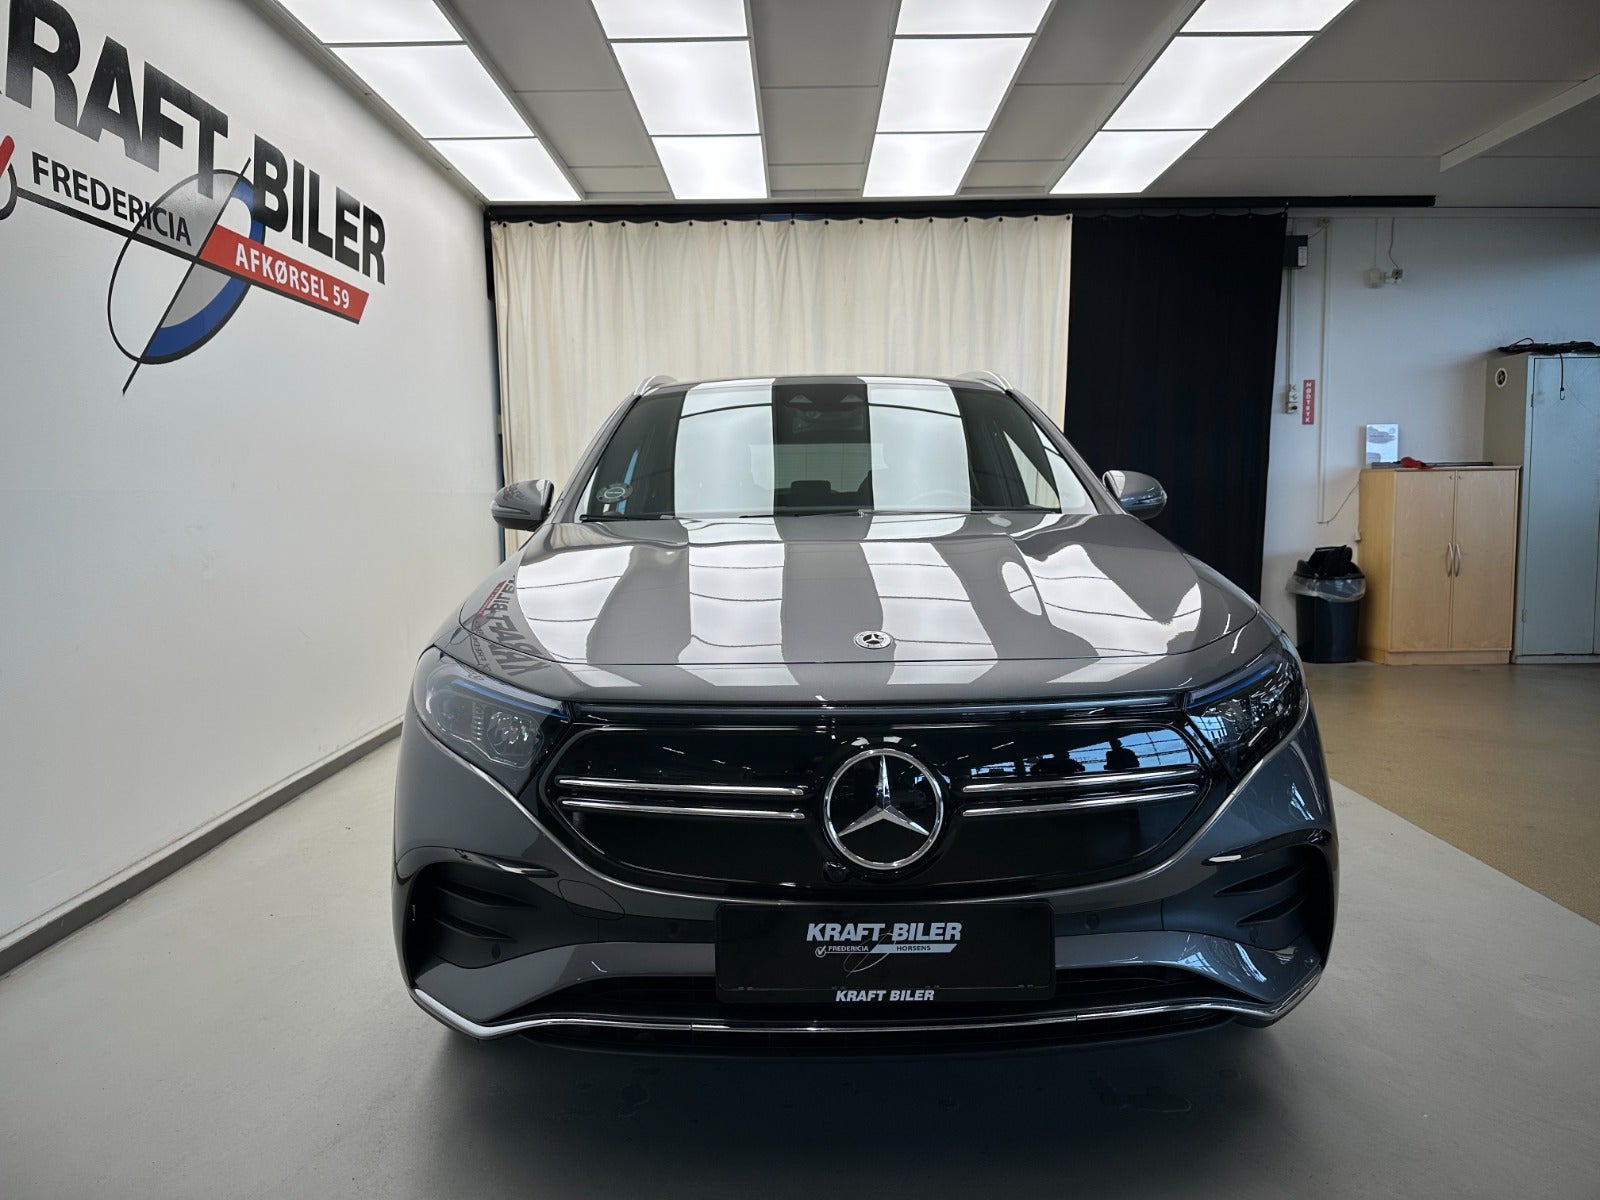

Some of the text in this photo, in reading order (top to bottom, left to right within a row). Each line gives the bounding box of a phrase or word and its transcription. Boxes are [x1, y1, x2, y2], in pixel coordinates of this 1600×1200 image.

[0, 0, 386, 285] RAFT BILER
[32, 151, 191, 246] FREDERICIA
[235, 243, 350, 309] AFKØRSEL 59
[806, 922, 962, 941] KRAFT BILER
[836, 990, 935, 1002] KRAFT BILER
